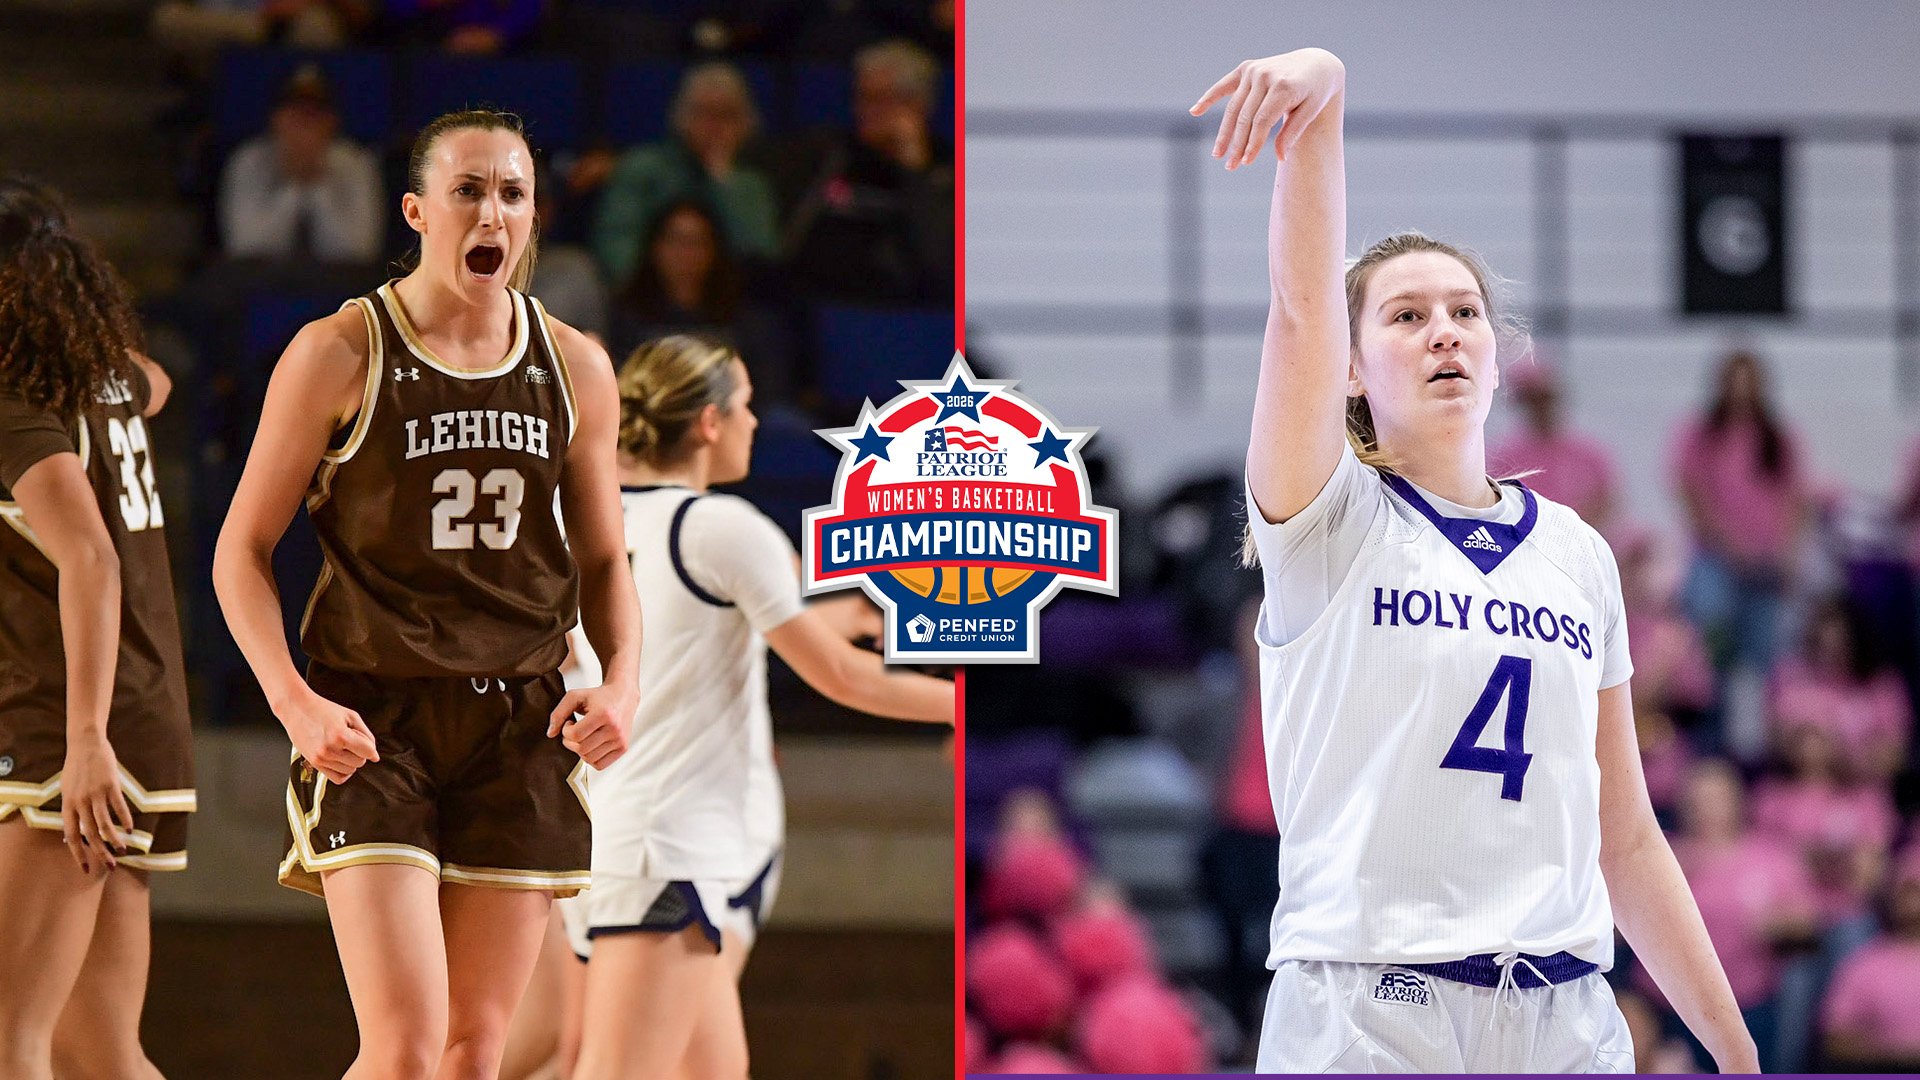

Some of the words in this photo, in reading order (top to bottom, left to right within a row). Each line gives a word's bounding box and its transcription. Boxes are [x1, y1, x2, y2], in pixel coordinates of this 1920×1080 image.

[405, 410, 549, 460] LEHIGH
[431, 468, 525, 550] 23
[1462, 538, 1503, 553] adidas
[1373, 587, 1473, 630] HOLY
[1484, 599, 1593, 660] CROSS
[1439, 654, 1533, 802] 4
[1373, 992, 1429, 1006] LEAGUE
[1374, 985, 1430, 999] PATRIOT
